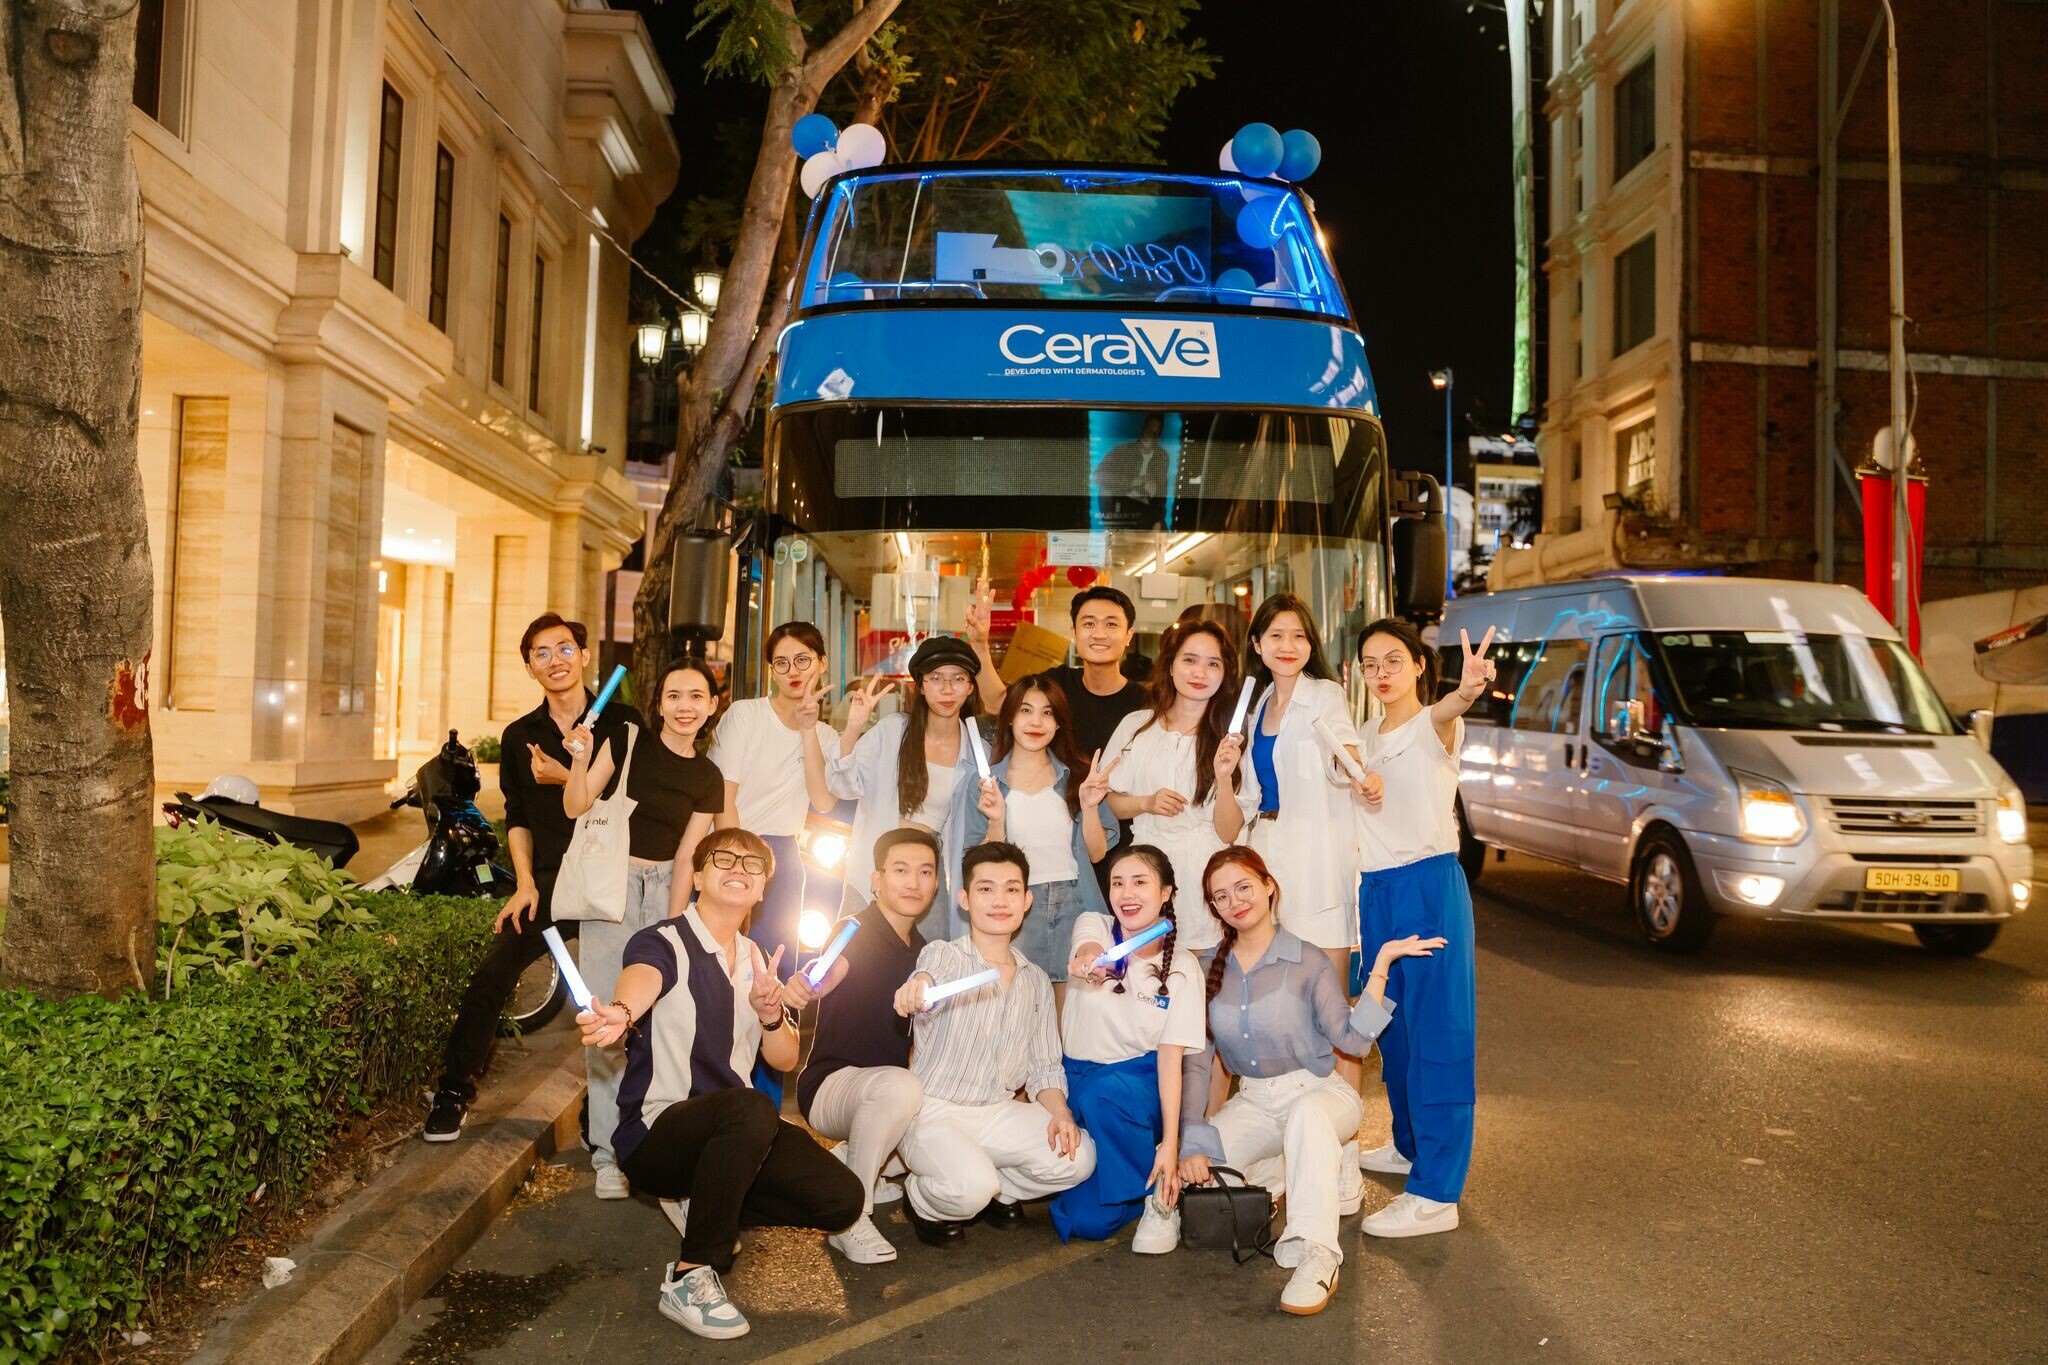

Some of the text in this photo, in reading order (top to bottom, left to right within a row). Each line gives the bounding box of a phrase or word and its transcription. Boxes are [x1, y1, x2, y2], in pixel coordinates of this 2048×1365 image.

[999, 323, 1211, 367] CeraVe
[1004, 367, 1146, 376] DEVELOPED WITH DERMATOLOGISTS
